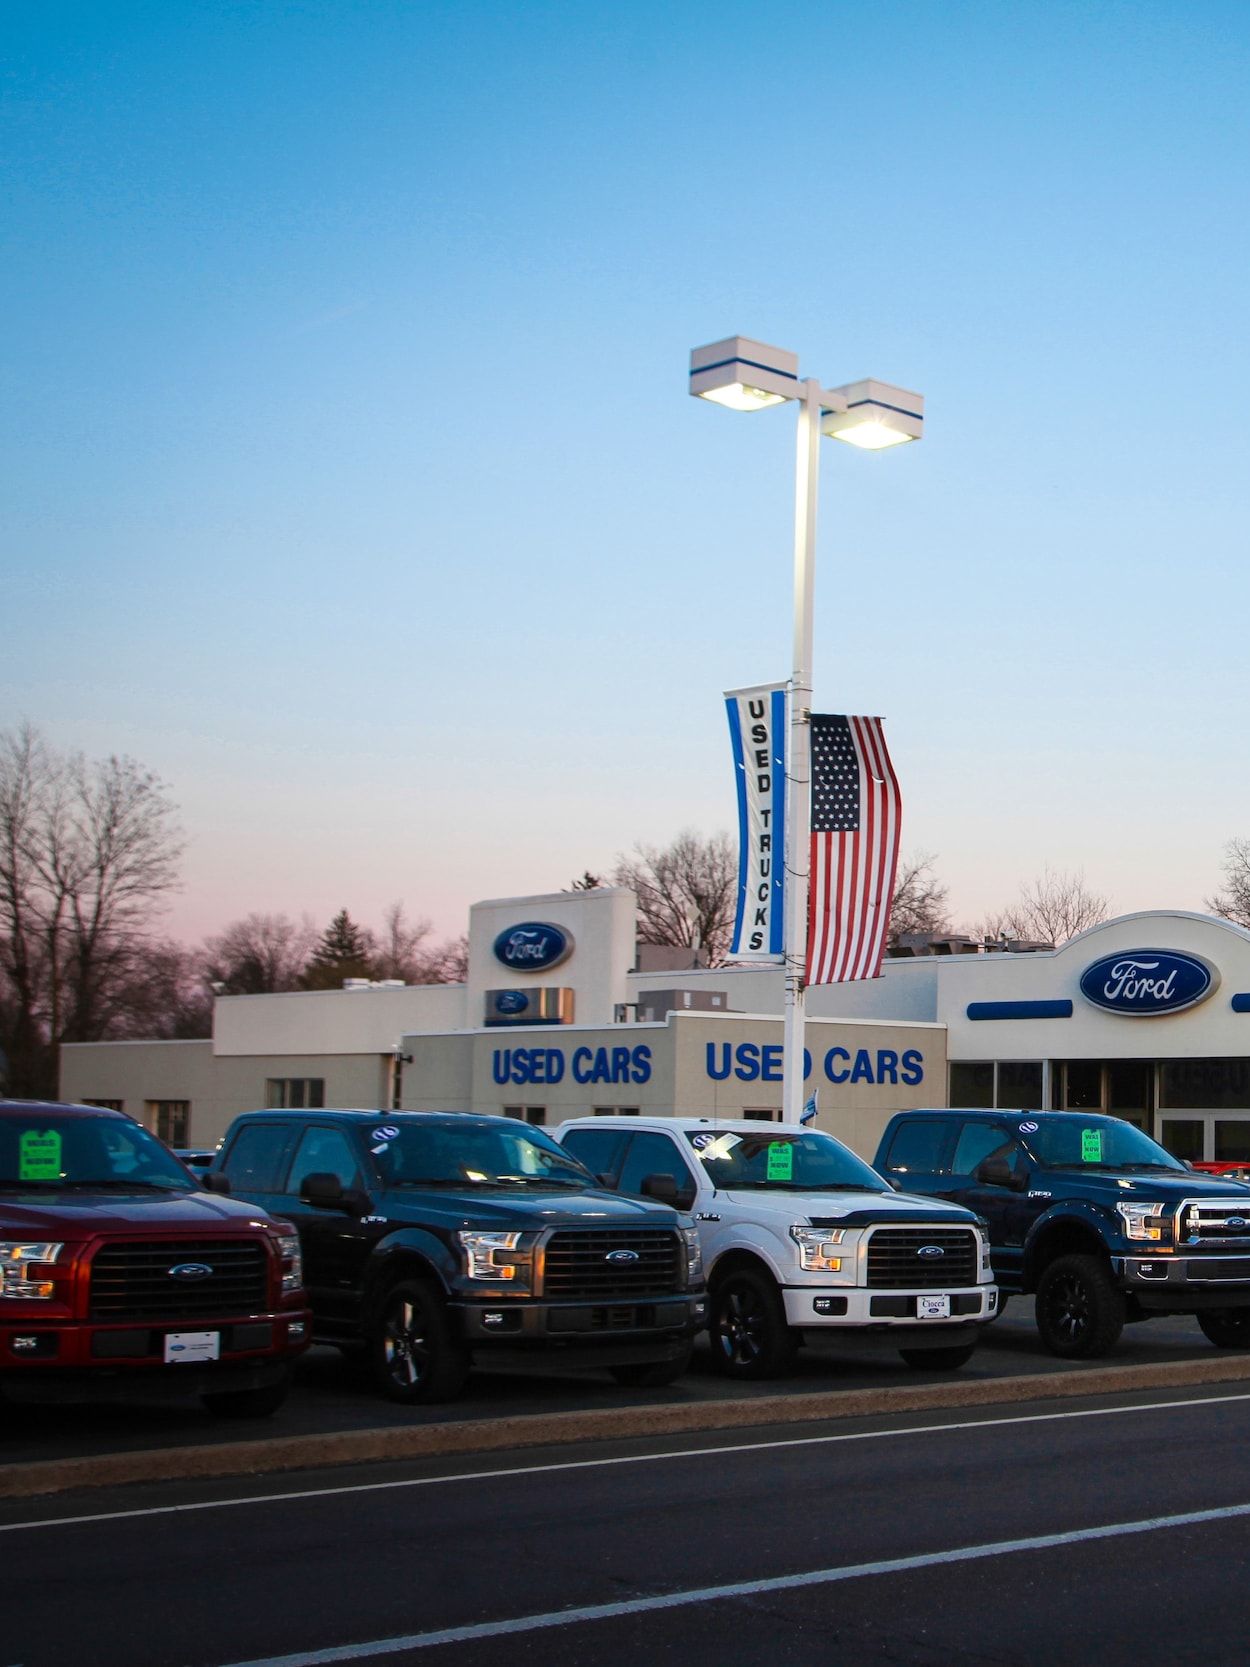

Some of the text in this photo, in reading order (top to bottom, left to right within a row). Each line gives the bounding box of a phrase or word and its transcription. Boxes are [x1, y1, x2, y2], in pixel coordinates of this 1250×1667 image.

[748, 699, 771, 950] USED TRUCKS
[505, 931, 548, 959] Ford
[1103, 960, 1177, 999] Ford
[493, 1045, 652, 1084] USED CARS
[824, 1046, 924, 1085] CARS
[1022, 1122, 1036, 1132] 16
